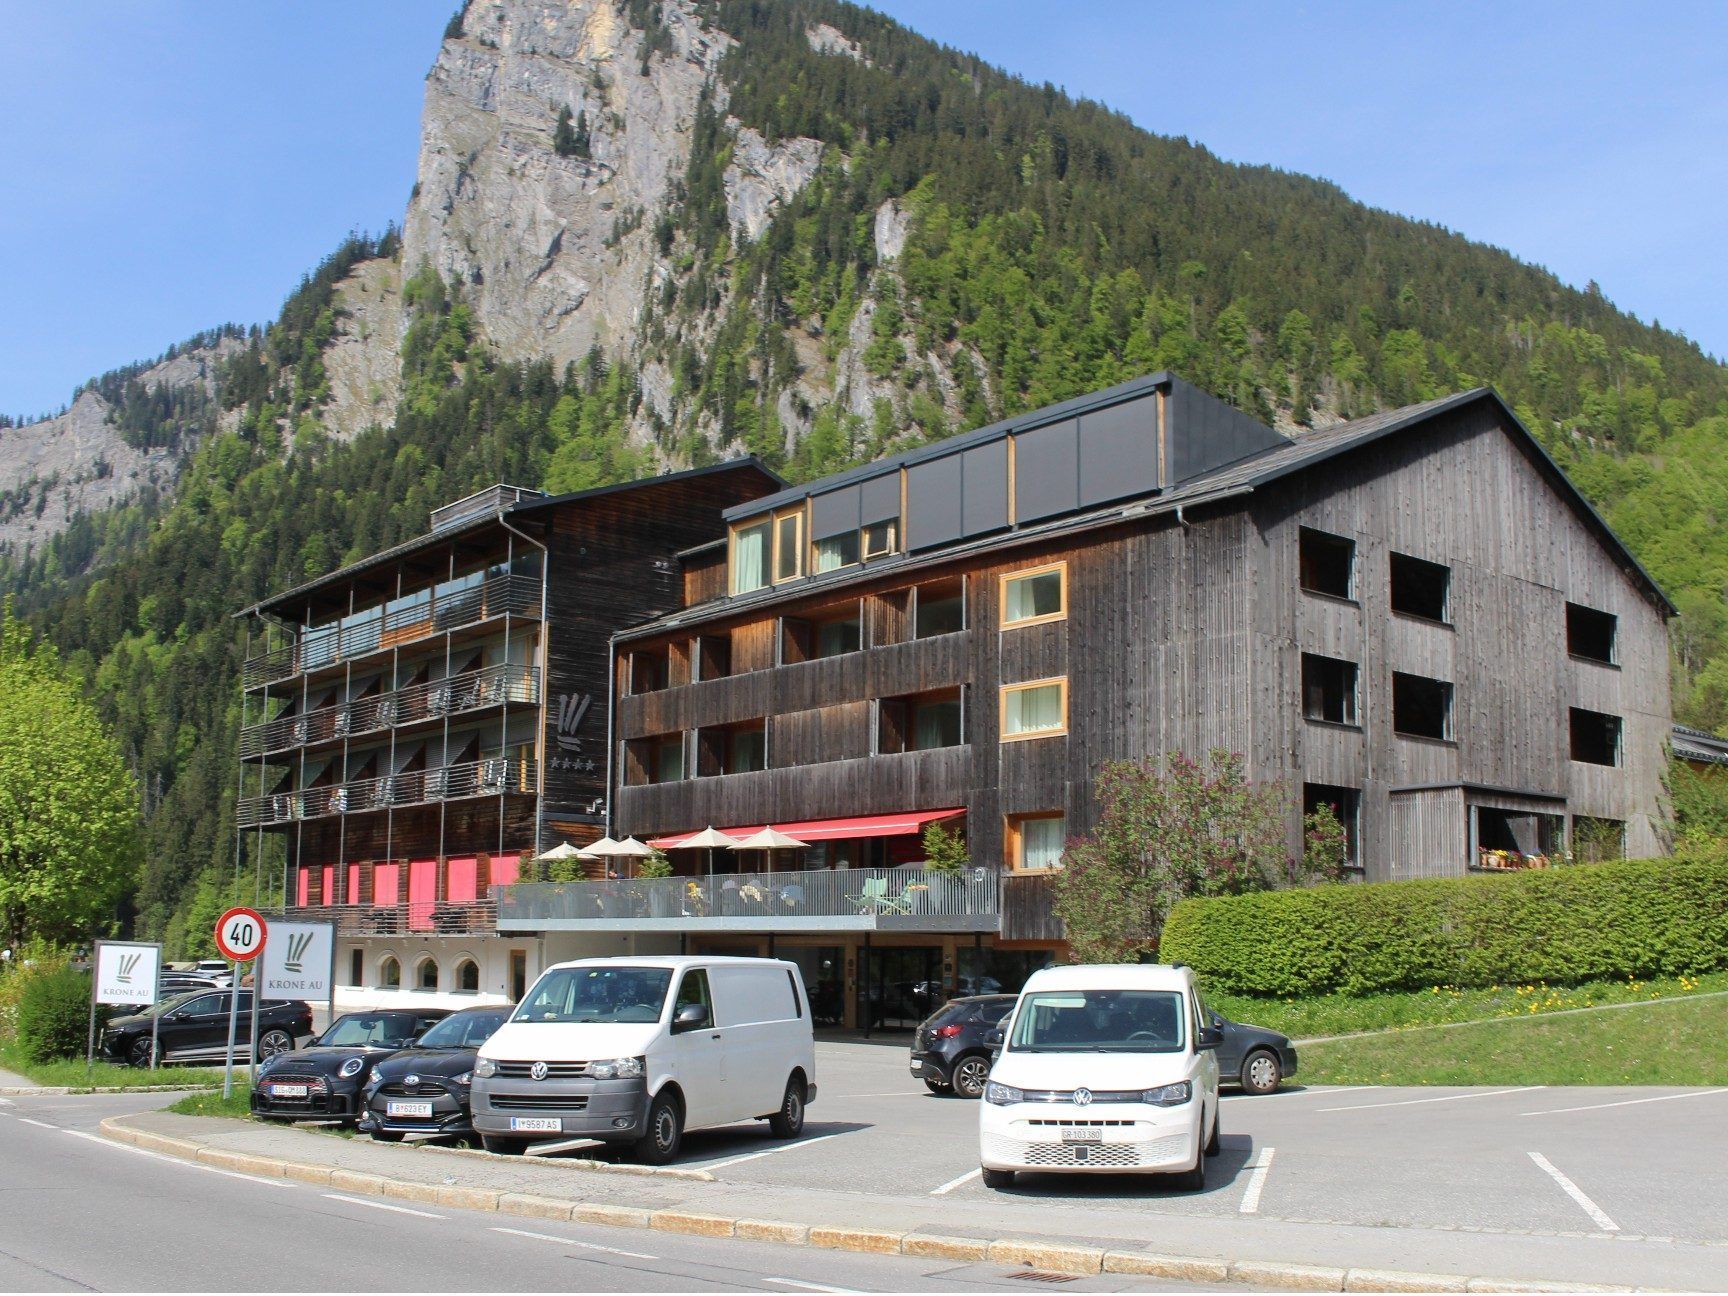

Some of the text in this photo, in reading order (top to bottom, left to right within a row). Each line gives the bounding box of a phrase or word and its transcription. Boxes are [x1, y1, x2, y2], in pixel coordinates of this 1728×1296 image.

[230, 923, 252, 946] 40
[268, 980, 322, 989] KRONE AU
[103, 988, 134, 996] KRONE
